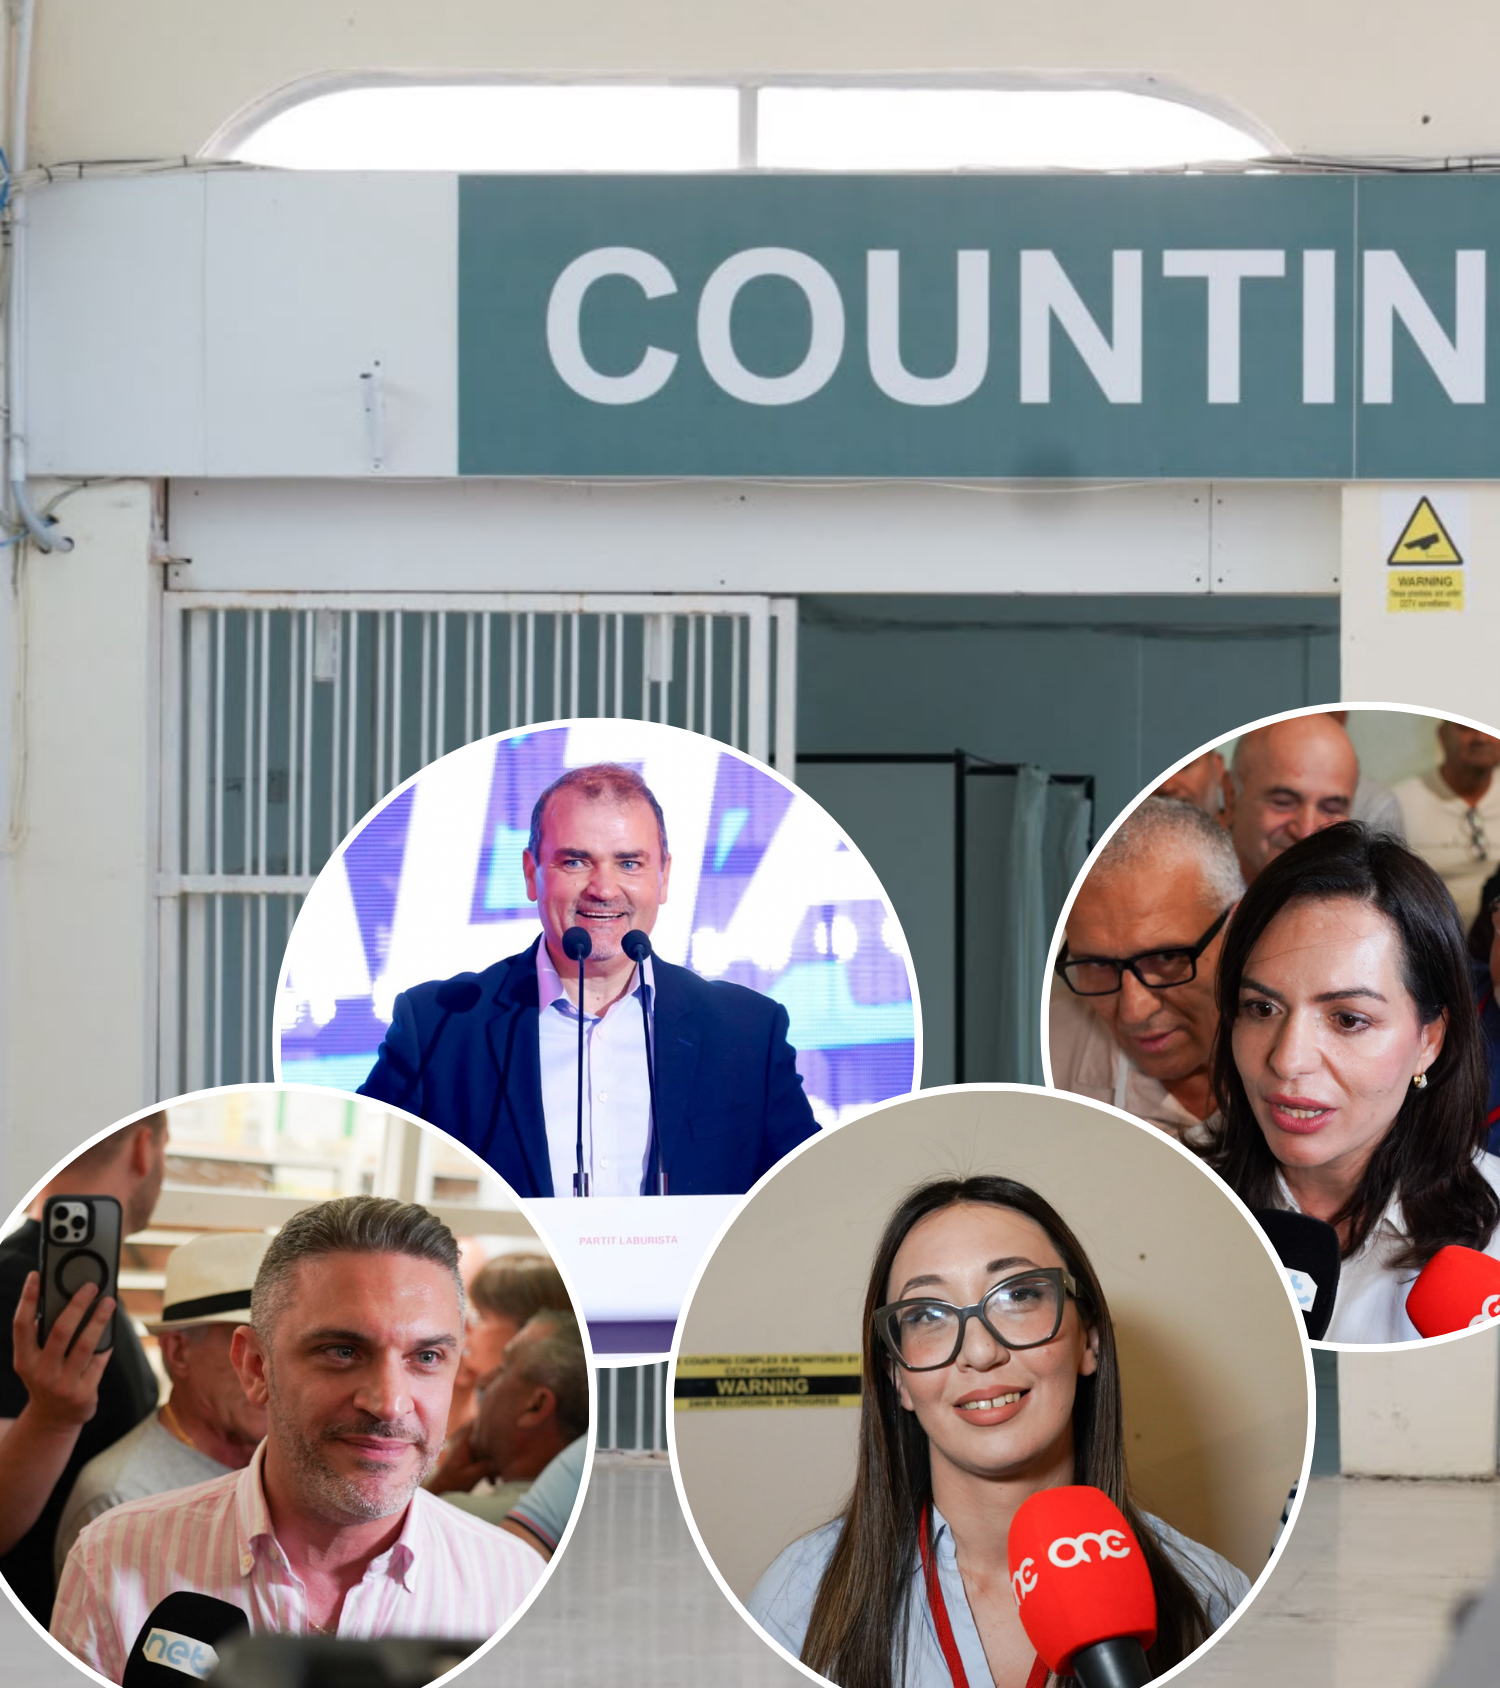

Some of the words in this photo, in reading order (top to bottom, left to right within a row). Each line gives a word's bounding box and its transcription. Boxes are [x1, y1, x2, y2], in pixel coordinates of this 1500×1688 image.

[1398, 576, 1453, 587] WARNING
[579, 1236, 617, 1246] PARTIT
[619, 1235, 679, 1246] LABURISTA
[684, 1356, 732, 1366] COUNTING
[735, 1355, 778, 1365] COMPLEX
[792, 1354, 843, 1364] MONITORED
[847, 1354, 859, 1363] BY
[725, 1367, 751, 1376] CCTV
[754, 1366, 800, 1376] CAMERAS
[716, 1377, 810, 1396] WARNING
[716, 1399, 773, 1408] RECORDING
[787, 1397, 840, 1407] PROGRESS
[145, 1632, 212, 1676] net
